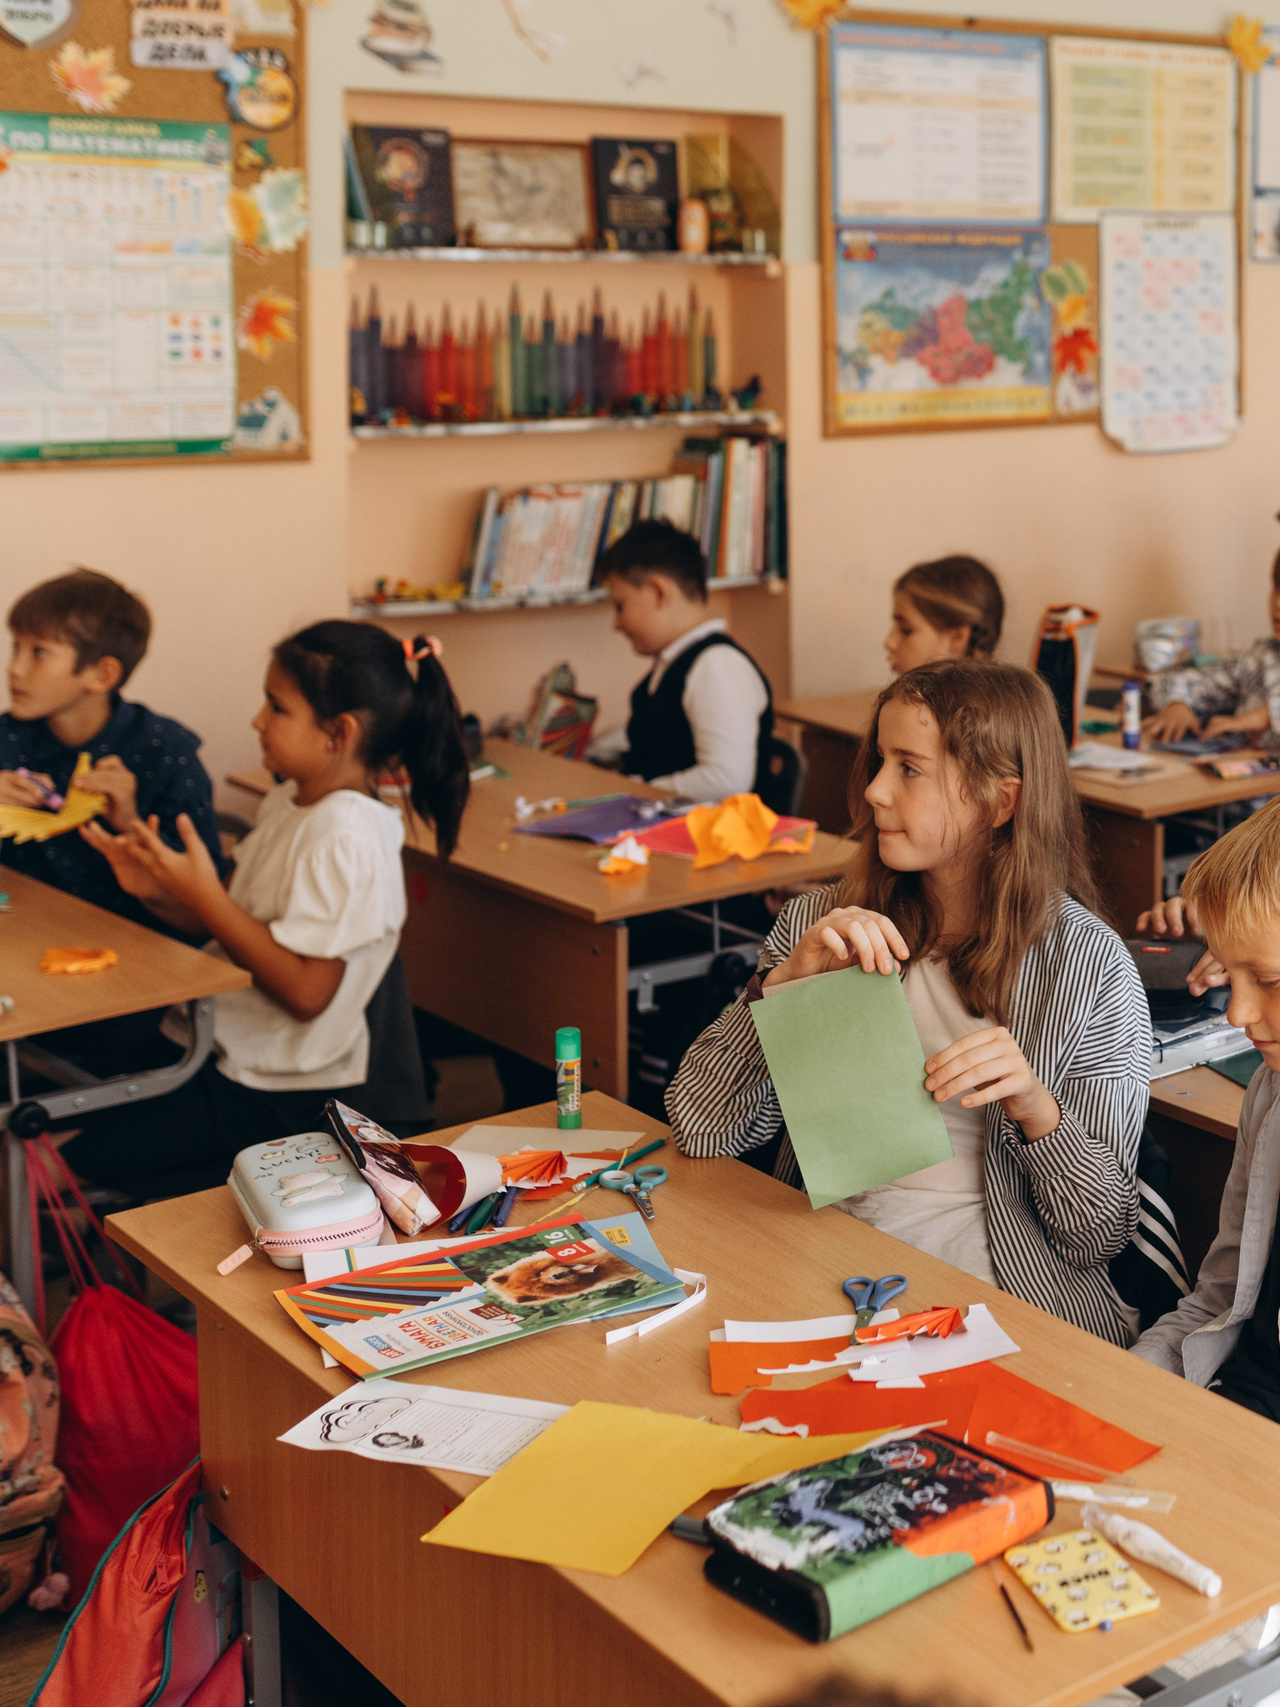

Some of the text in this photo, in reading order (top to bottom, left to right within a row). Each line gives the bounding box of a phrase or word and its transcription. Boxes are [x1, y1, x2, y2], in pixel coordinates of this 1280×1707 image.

[544, 1231, 568, 1244] 16
[557, 1247, 577, 1257] 8
[398, 1321, 447, 1350] БУМАГА
[422, 1315, 468, 1343] ЦВЕТНАЯ
